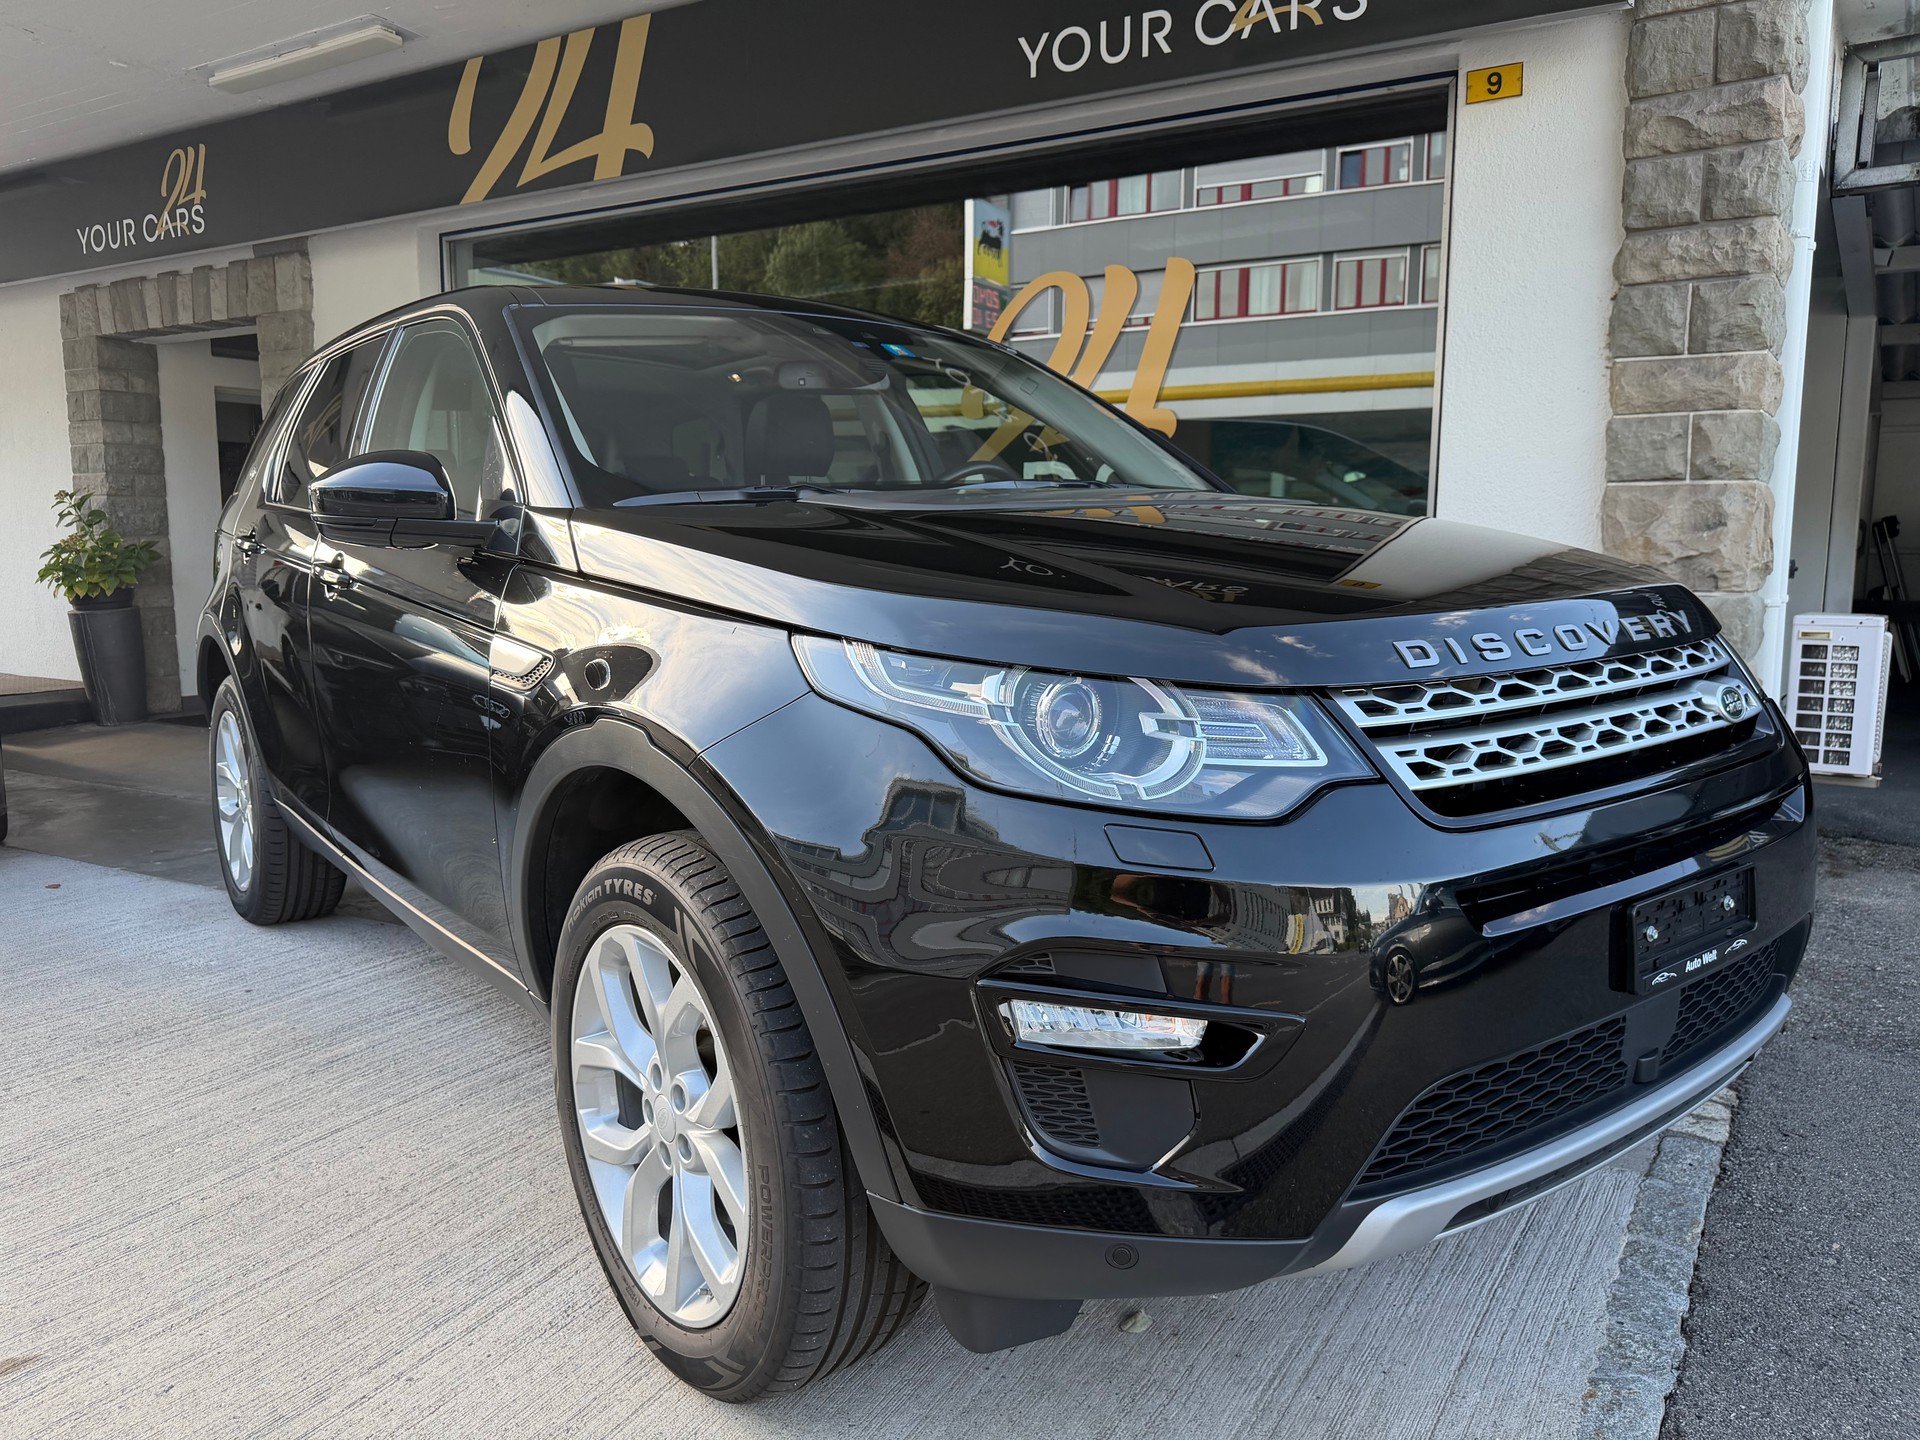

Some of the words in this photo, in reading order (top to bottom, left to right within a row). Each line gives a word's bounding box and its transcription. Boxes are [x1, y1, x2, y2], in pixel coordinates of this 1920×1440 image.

[1017, 9, 1173, 79] YOUR
[1487, 72, 1502, 95] 9
[157, 143, 207, 236] 24
[76, 218, 137, 255] YOUR
[142, 204, 205, 243] CARS
[1392, 609, 1692, 669] DISCOVERY
[603, 878, 654, 906] TYRES
[1685, 957, 1702, 973] Auto
